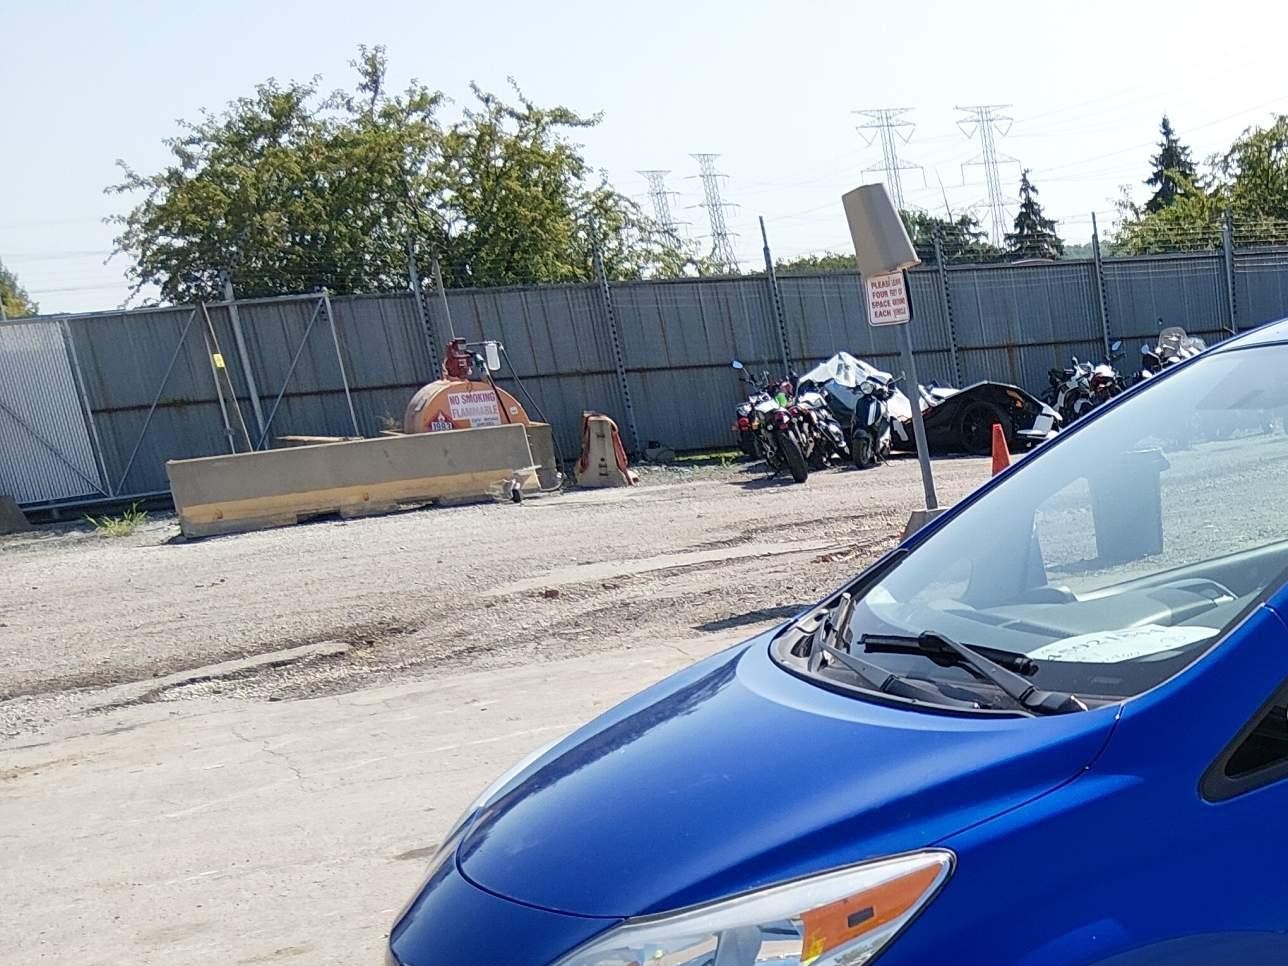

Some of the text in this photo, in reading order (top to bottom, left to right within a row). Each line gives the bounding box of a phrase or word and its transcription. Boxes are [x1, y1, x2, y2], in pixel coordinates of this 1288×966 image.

[872, 290, 888, 300] FOUR
[874, 309, 891, 318] EACH
[449, 392, 496, 405] NO SMOKING
[452, 405, 498, 418] FLAMMABLE
